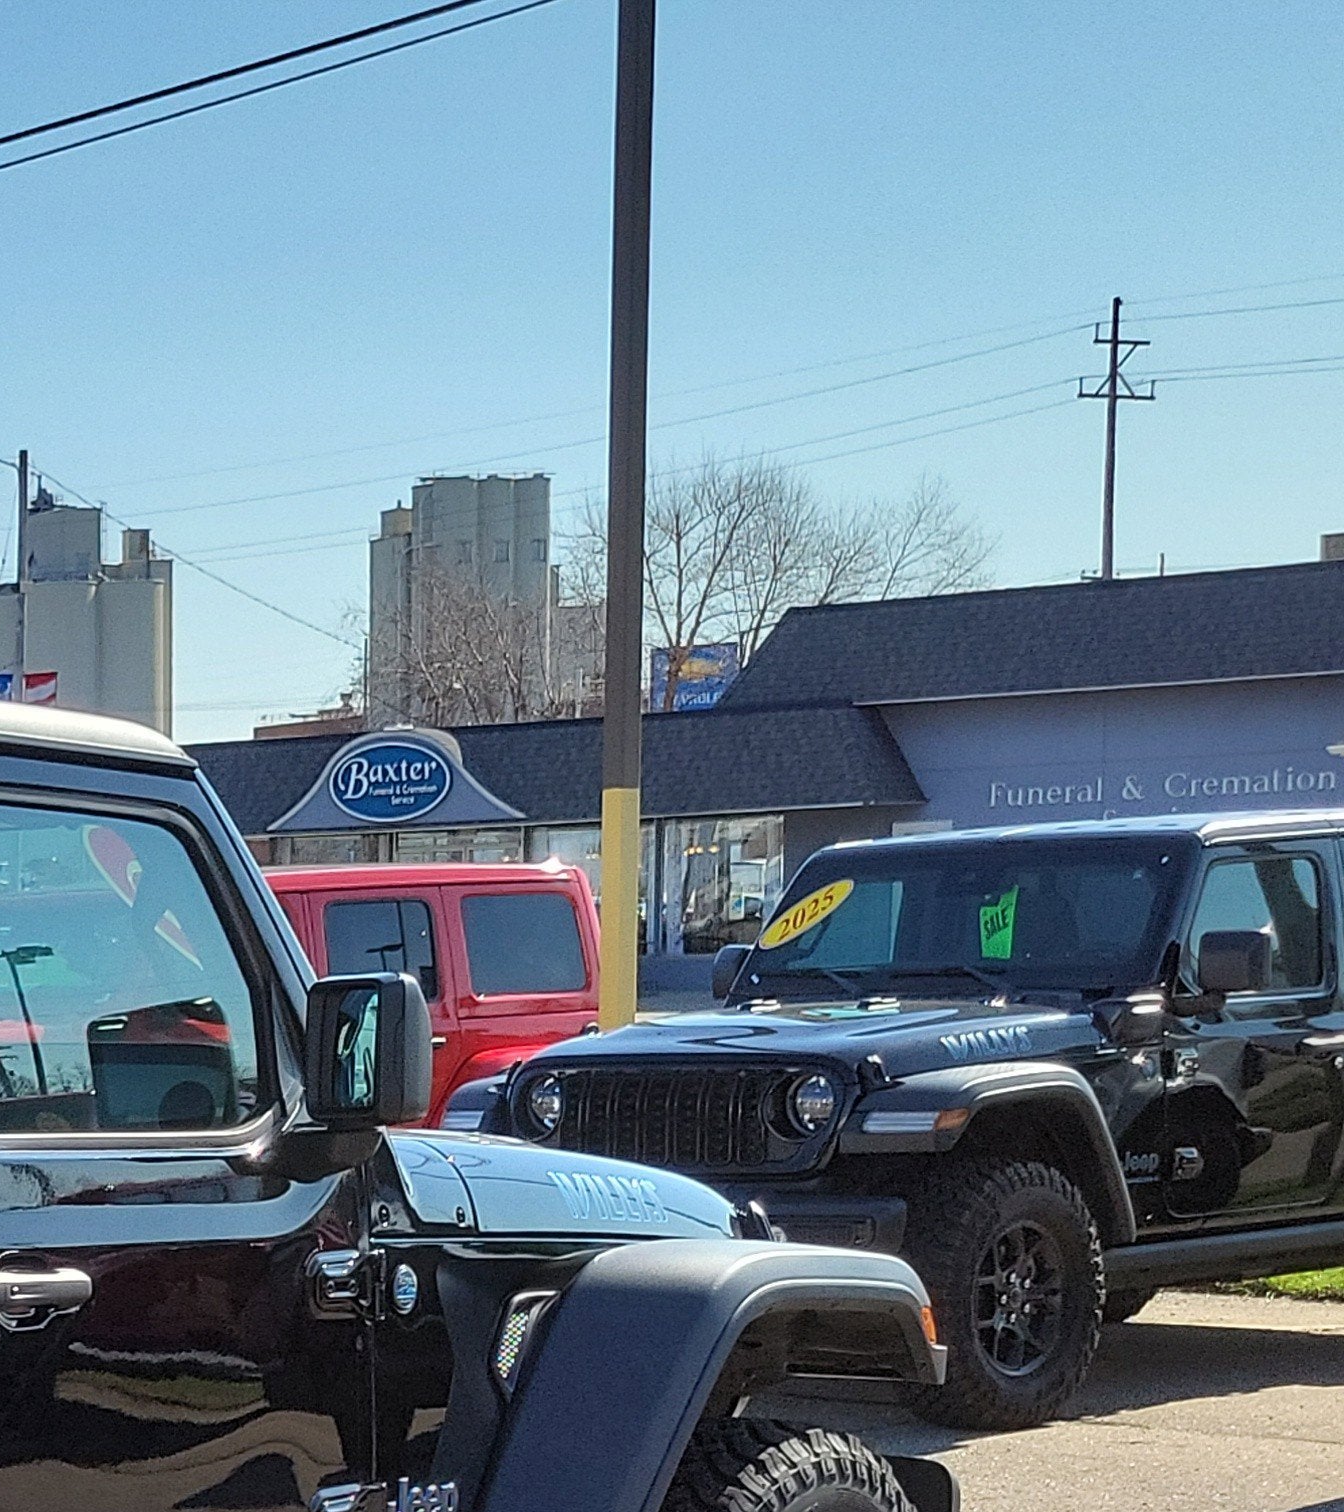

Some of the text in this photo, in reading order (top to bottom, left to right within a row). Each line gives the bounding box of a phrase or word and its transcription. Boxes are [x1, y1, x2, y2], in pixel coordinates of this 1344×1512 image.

[338, 758, 437, 799] Baxter
[990, 766, 1337, 808] Funeral & Cremation
[778, 887, 835, 940] 2025
[983, 908, 1010, 940] SALE
[940, 1026, 1032, 1060] WILLYS
[1124, 1151, 1159, 1173] Jeep
[547, 1171, 669, 1223] WILLYS
